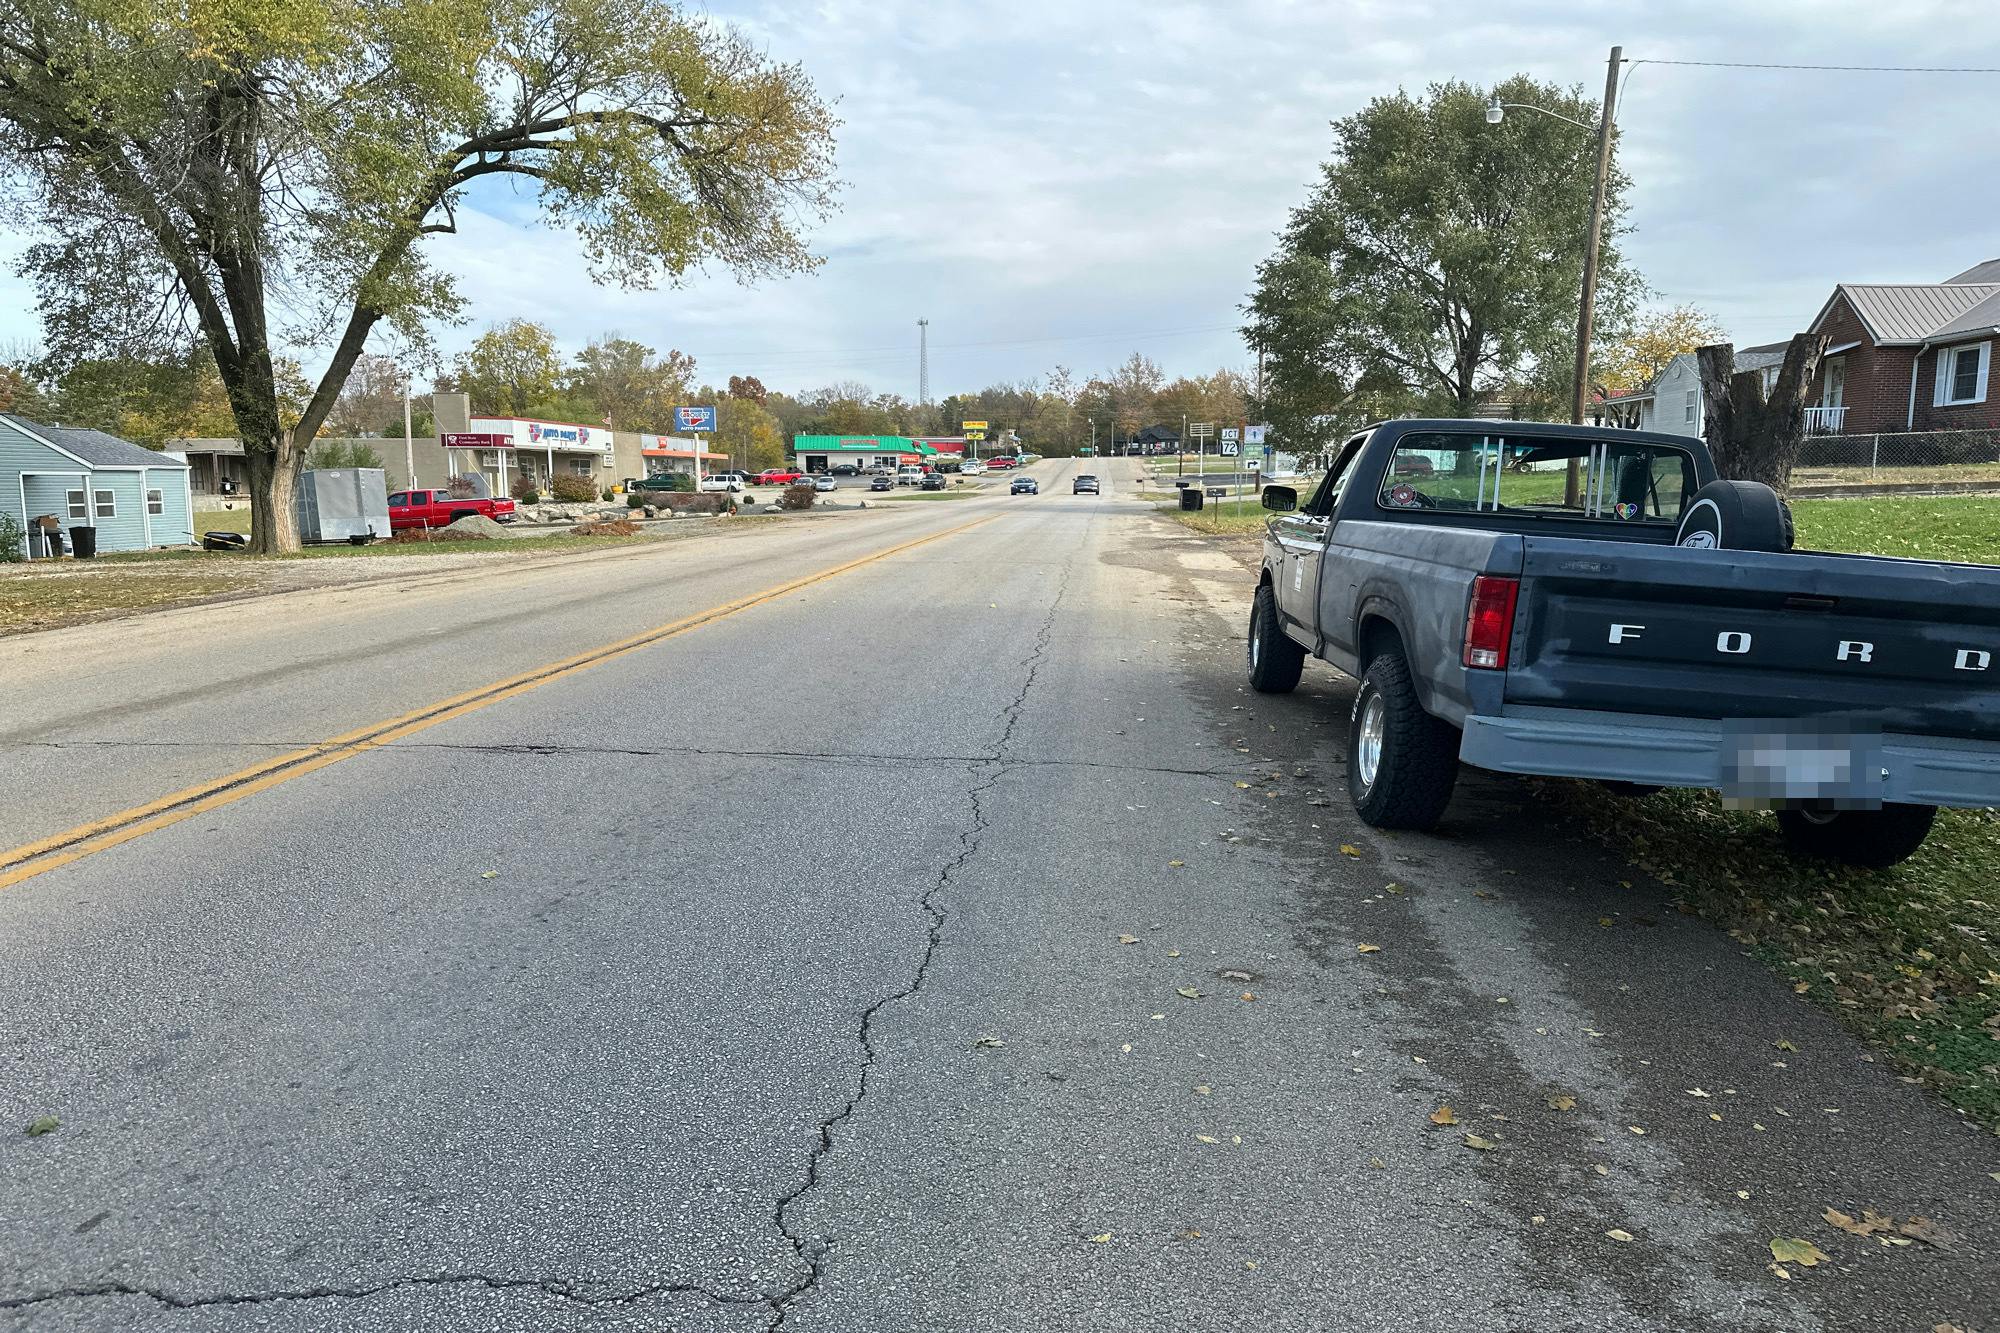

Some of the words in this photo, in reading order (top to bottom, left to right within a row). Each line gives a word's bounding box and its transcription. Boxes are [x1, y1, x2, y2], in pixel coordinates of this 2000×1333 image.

[543, 428, 560, 439] AUTO
[560, 430, 577, 442] PARTS
[1224, 430, 1238, 438] JCT
[1223, 442, 1237, 453] 72
[1608, 623, 1991, 671] FORD
